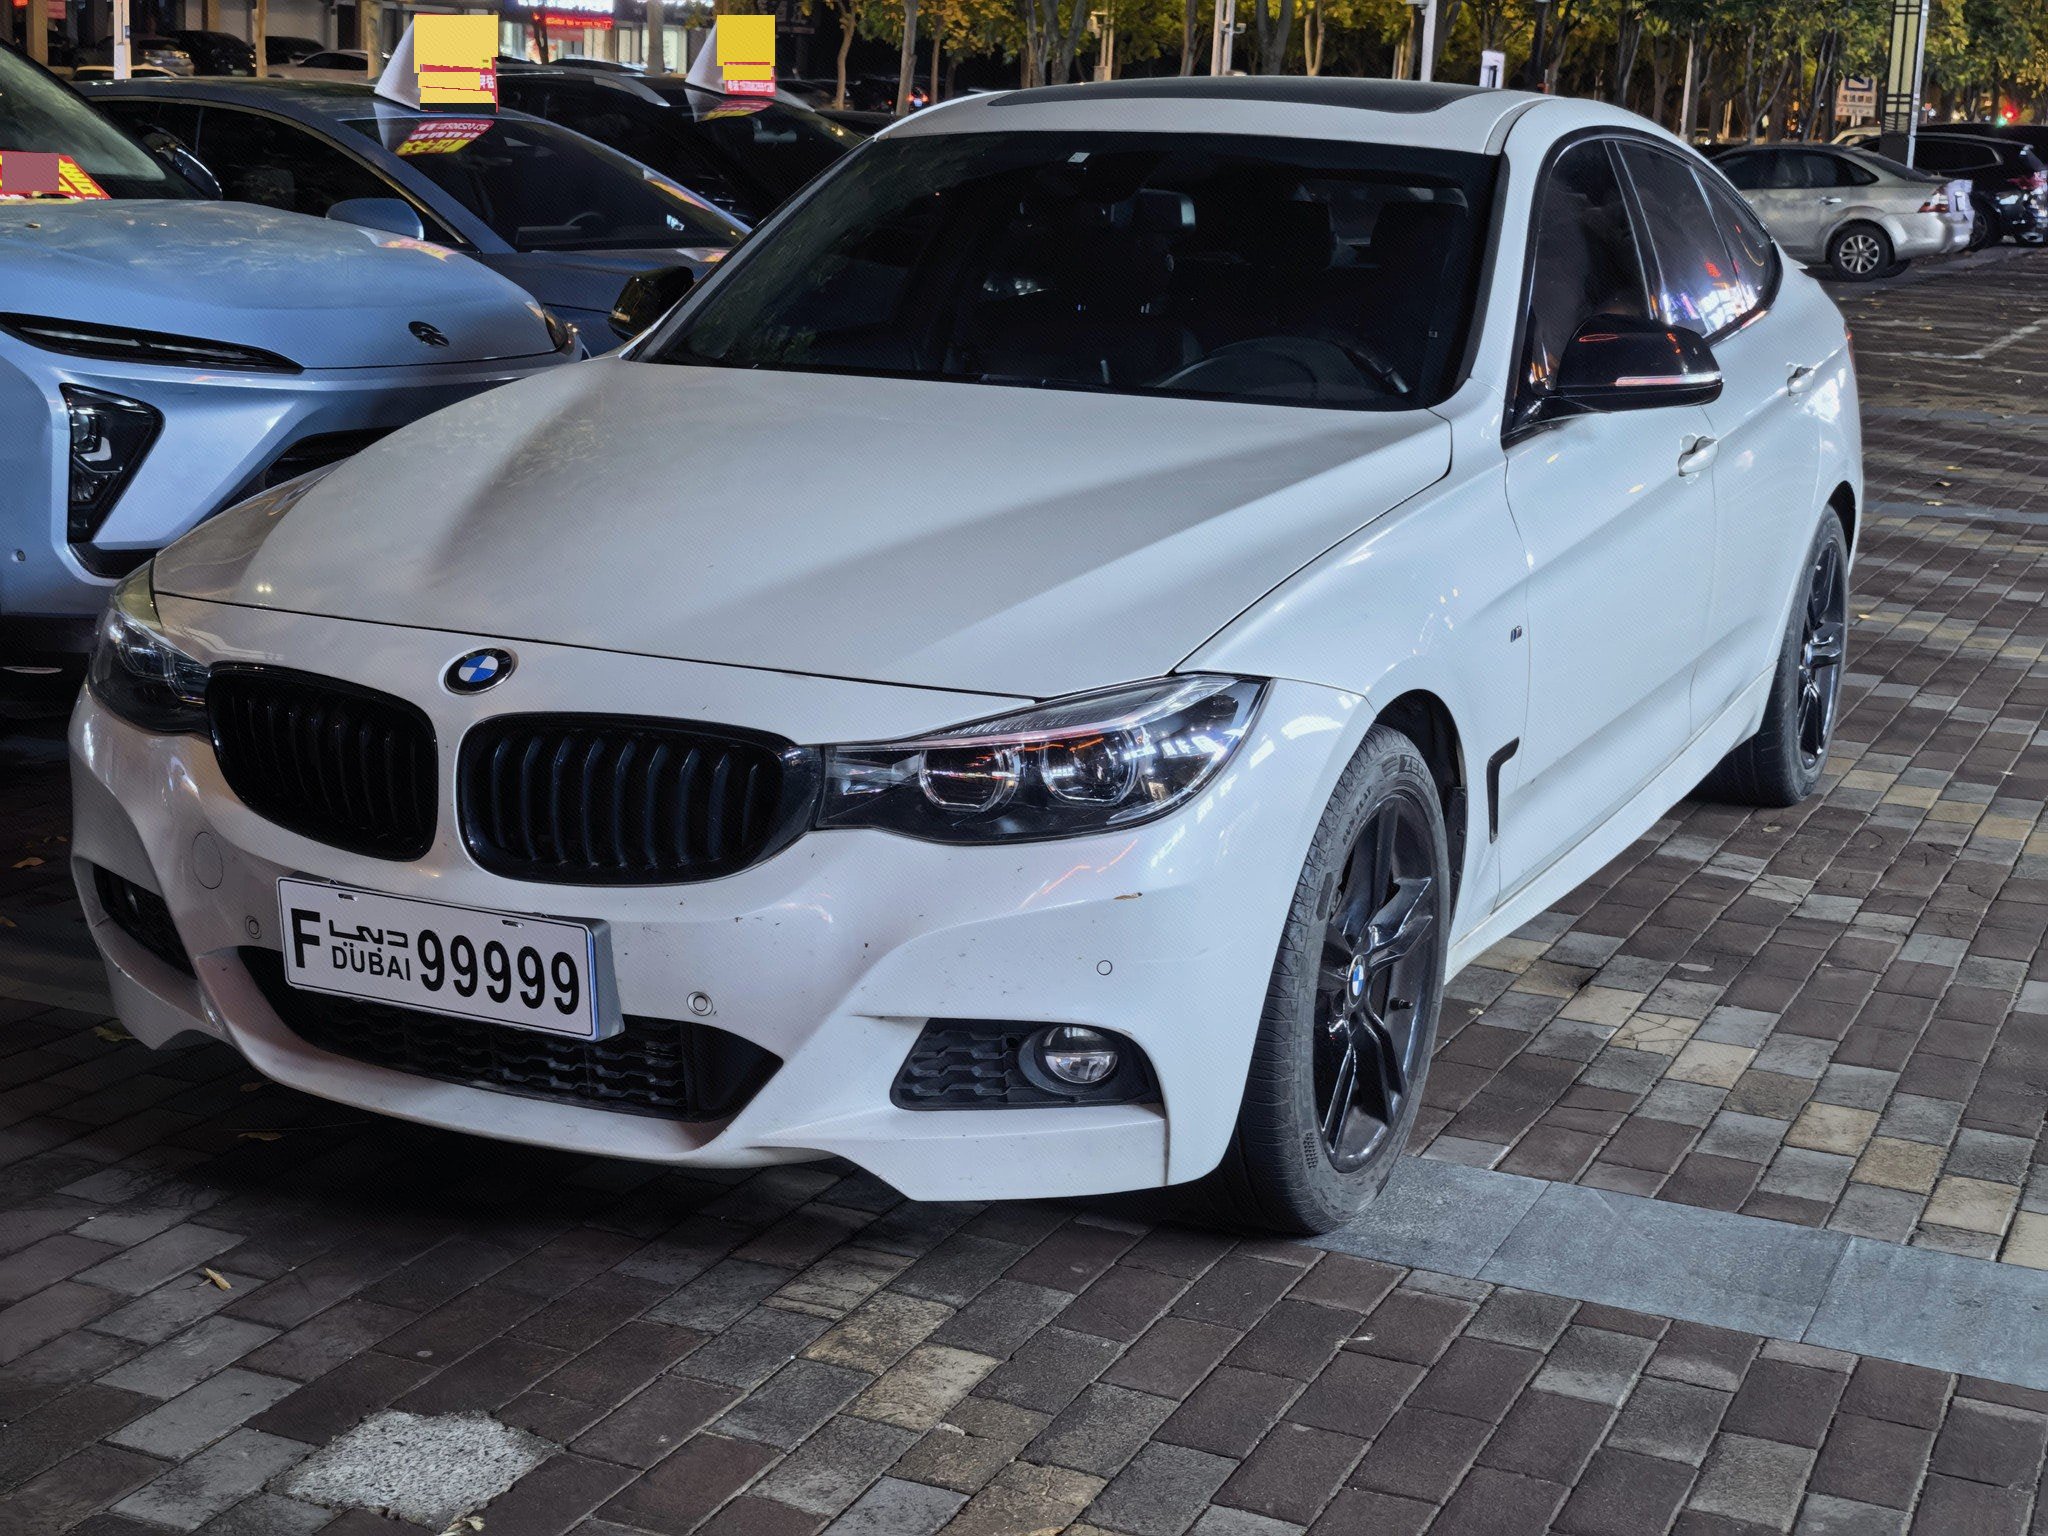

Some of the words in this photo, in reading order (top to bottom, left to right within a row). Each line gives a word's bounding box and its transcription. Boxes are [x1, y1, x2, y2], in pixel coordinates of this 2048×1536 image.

[290, 908, 321, 969] F
[332, 945, 411, 981] DUBAI
[417, 929, 579, 1016] 99999
